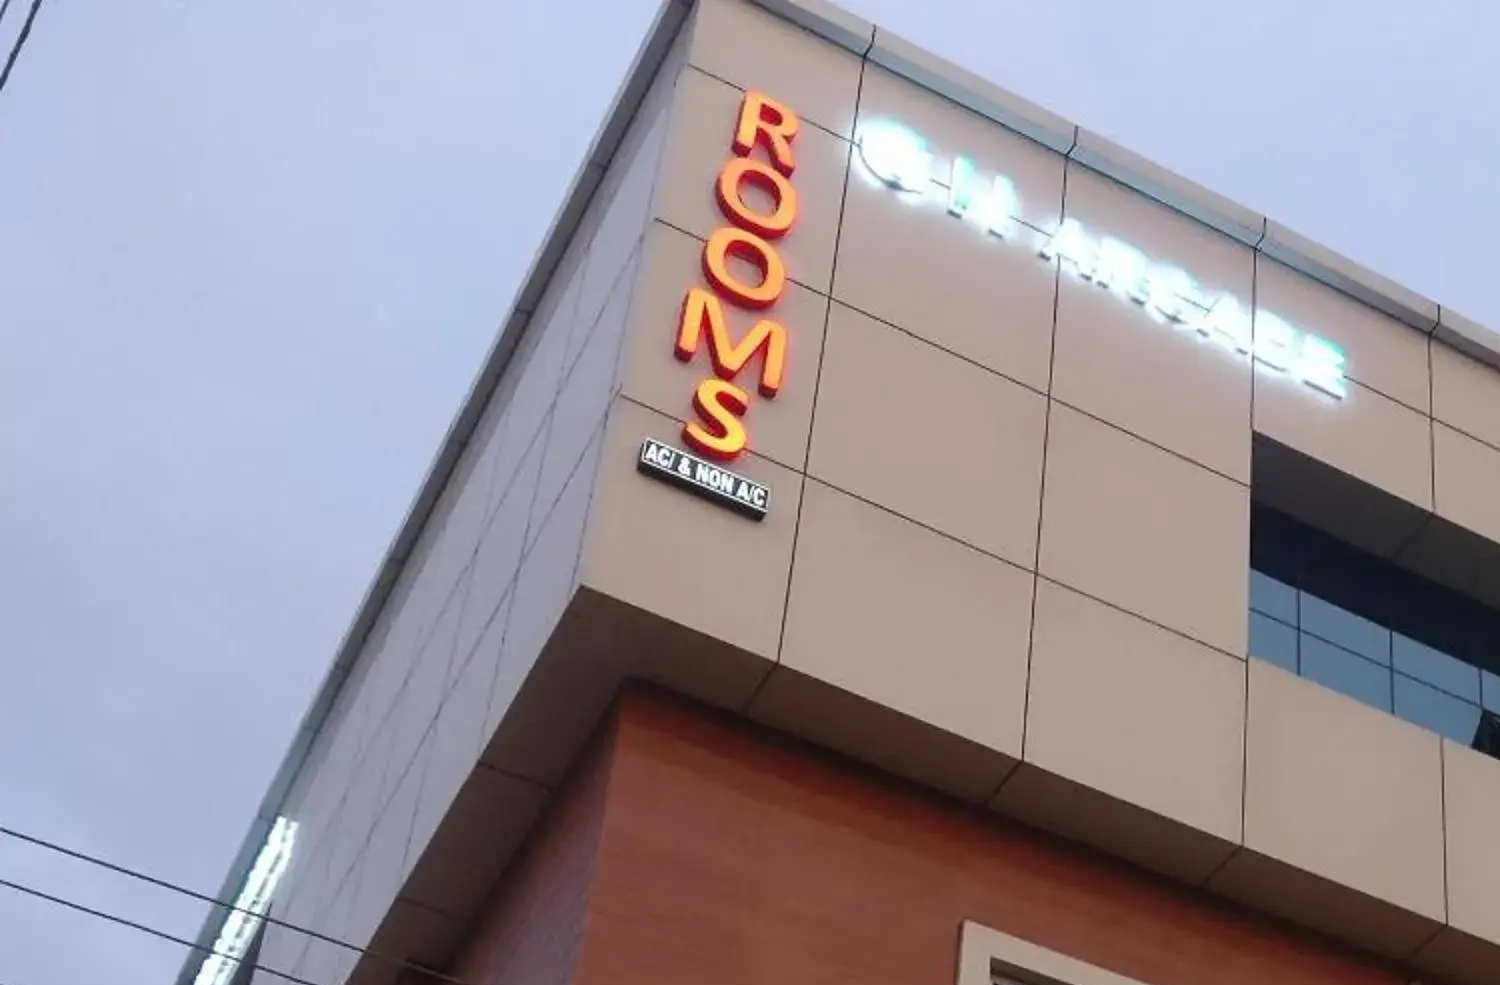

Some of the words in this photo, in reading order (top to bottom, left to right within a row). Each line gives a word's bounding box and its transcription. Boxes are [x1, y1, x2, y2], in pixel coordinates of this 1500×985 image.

[673, 89, 797, 461] ROOMS
[678, 457, 691, 476] &
[696, 463, 735, 494] NON
[736, 481, 766, 506] A/C
